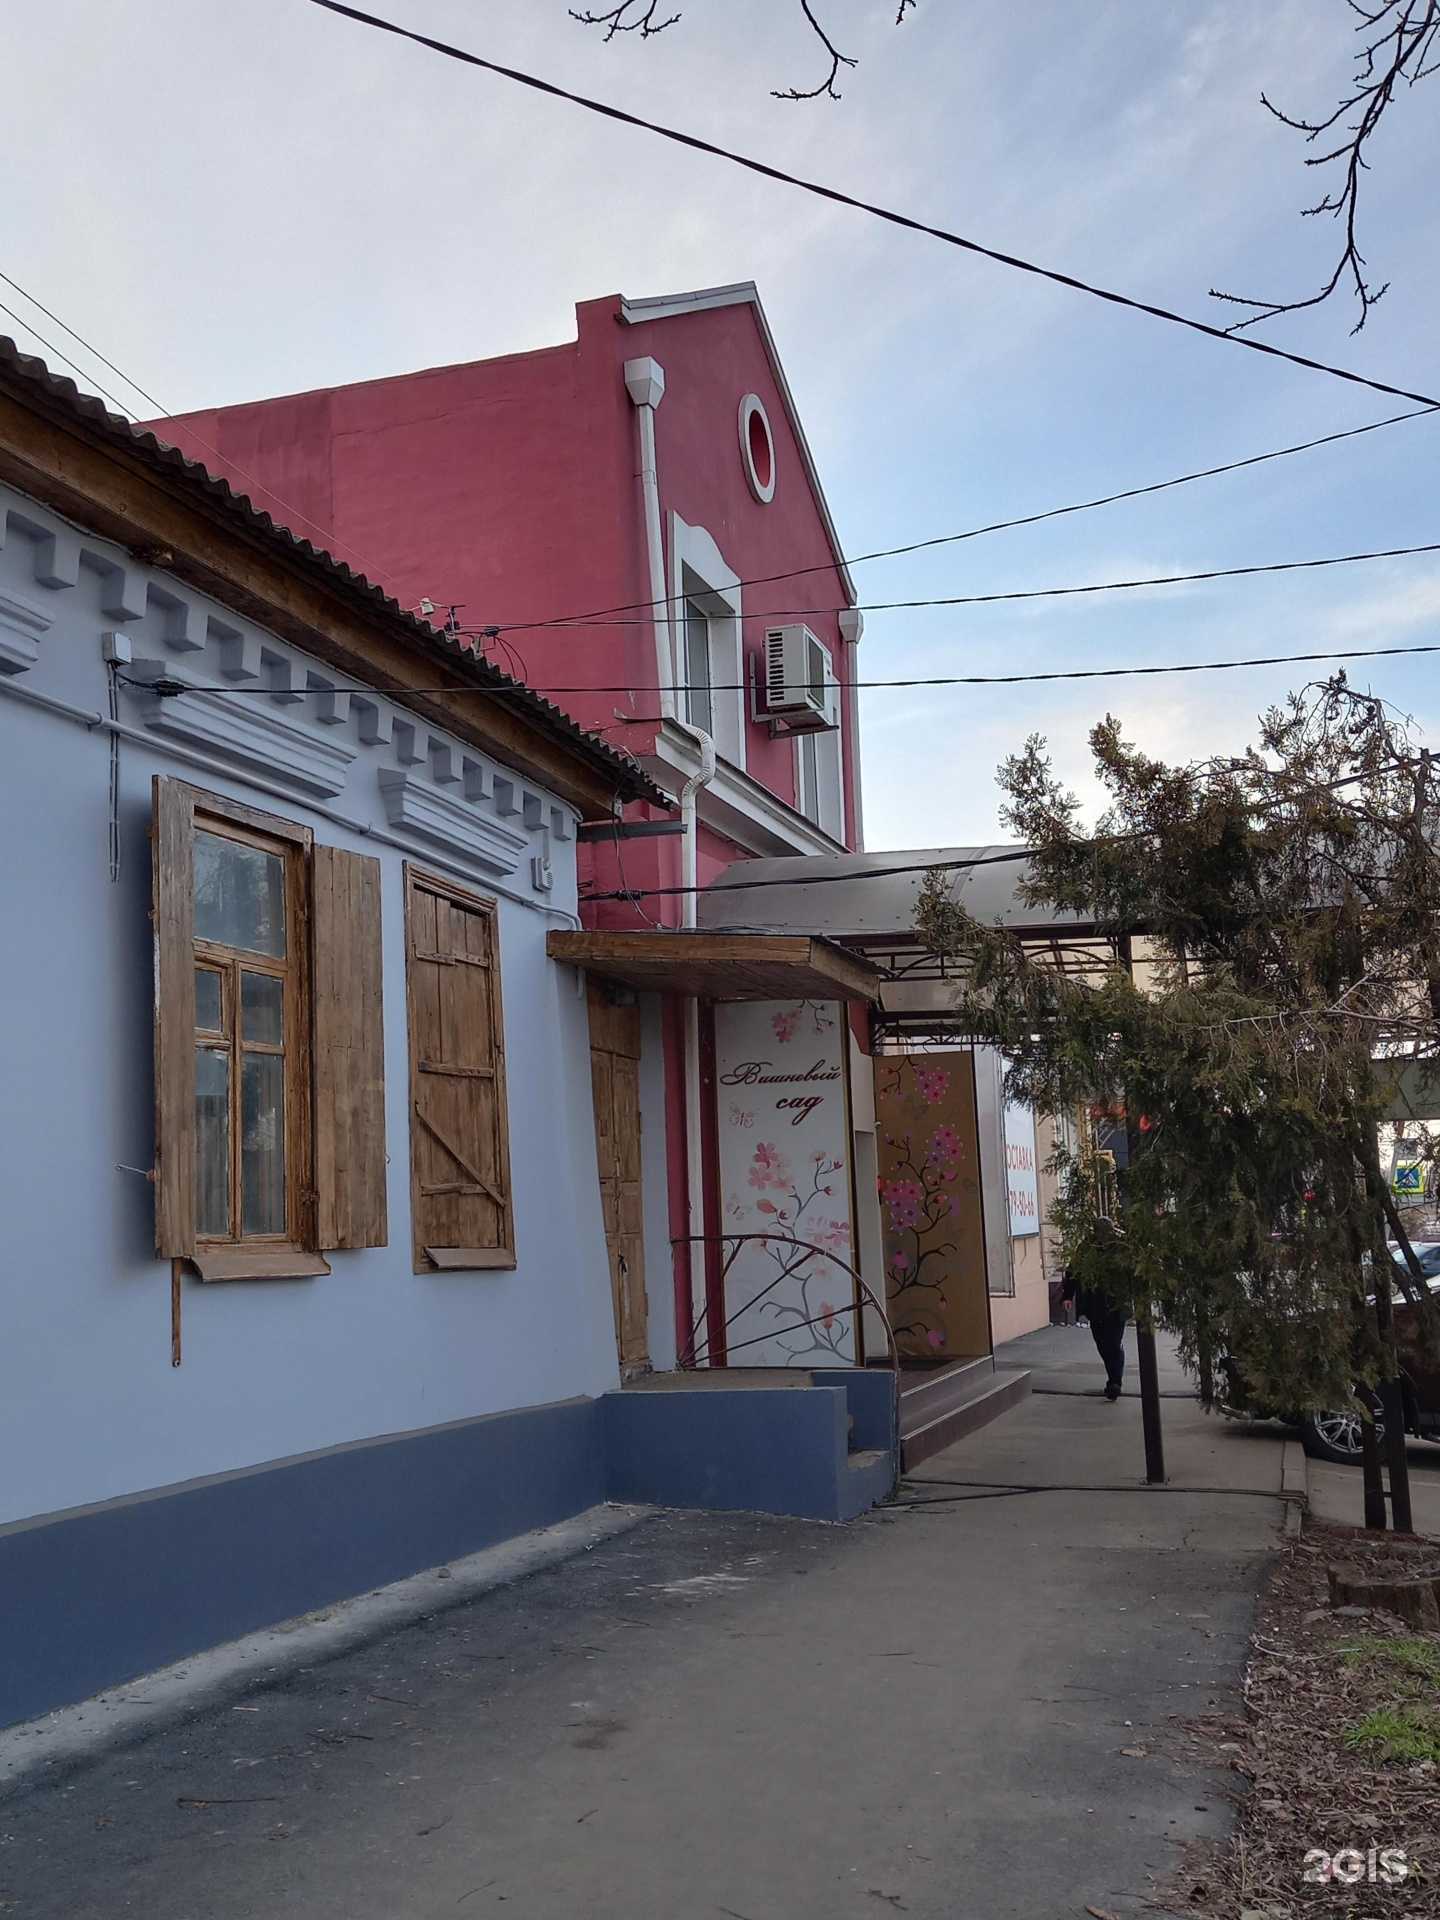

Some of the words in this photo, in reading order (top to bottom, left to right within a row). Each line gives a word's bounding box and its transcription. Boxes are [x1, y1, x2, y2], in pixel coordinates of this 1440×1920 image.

[719, 1059, 840, 1086] Вишневый
[775, 1095, 825, 1126] сад
[1006, 1143, 1034, 1171] ОСТАВКА
